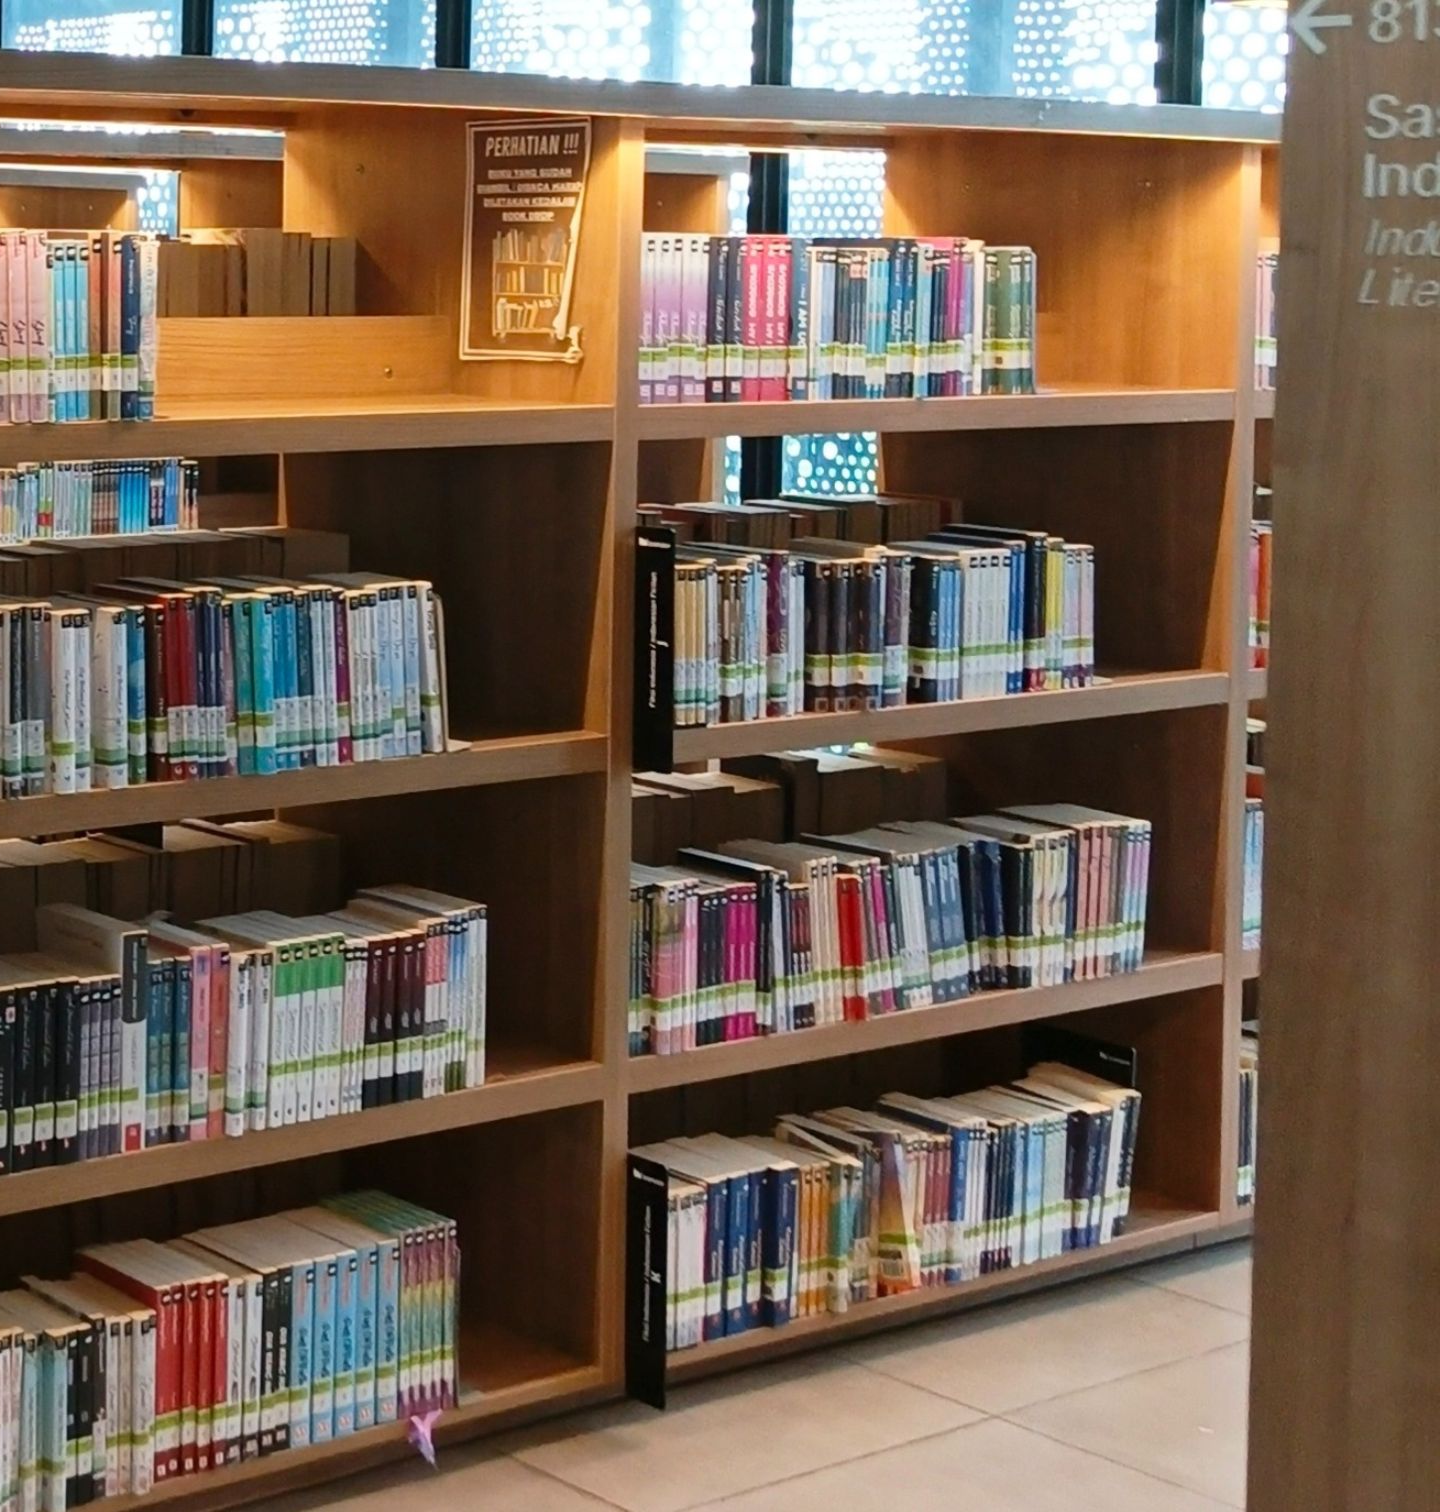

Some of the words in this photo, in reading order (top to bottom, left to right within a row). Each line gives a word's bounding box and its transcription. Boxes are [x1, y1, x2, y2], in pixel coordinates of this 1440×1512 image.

[1369, 0, 1440, 43] 81
[1364, 93, 1440, 140] Sa
[485, 134, 560, 157] PERHATIAN
[563, 132, 580, 155] !!!
